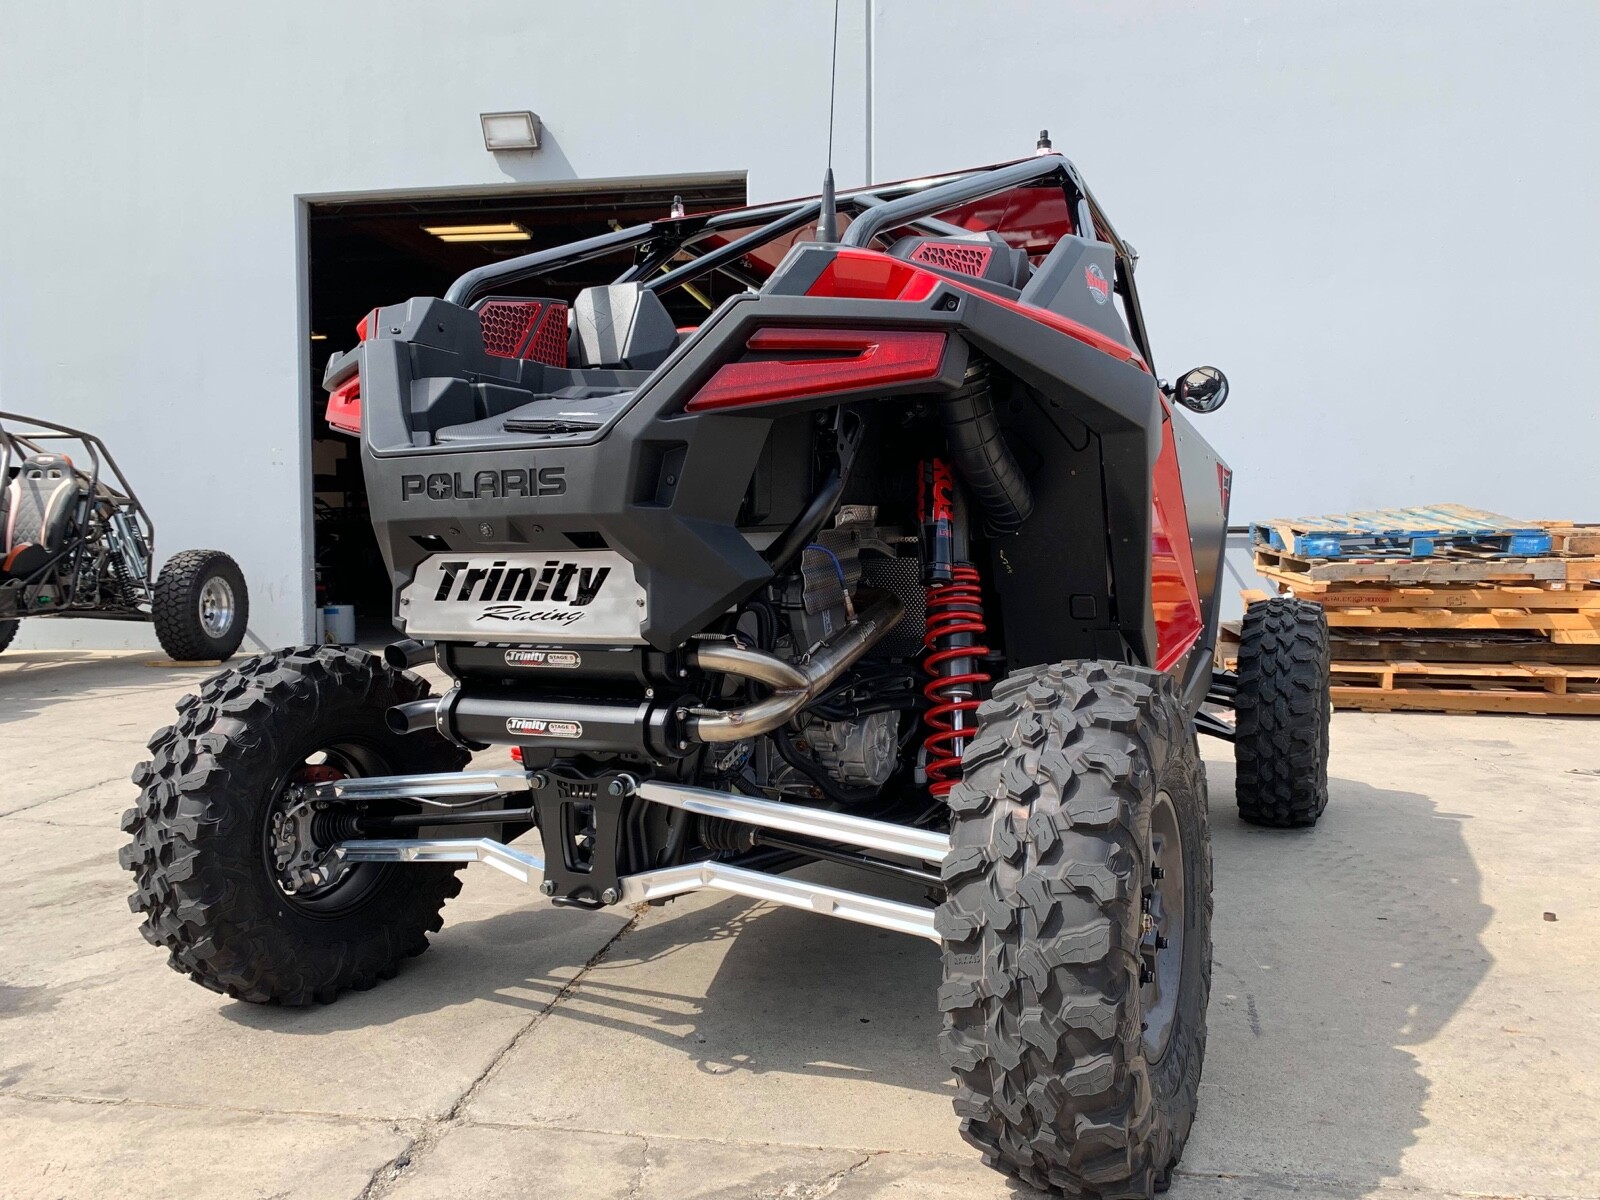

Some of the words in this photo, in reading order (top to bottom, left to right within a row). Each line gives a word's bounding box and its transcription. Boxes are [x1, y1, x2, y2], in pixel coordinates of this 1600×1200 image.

[401, 467, 567, 501] POLARIS
[435, 560, 611, 606] Trinity
[476, 605, 587, 626] Racing
[510, 652, 545, 662] Trinity
[511, 719, 547, 731] Trinity
